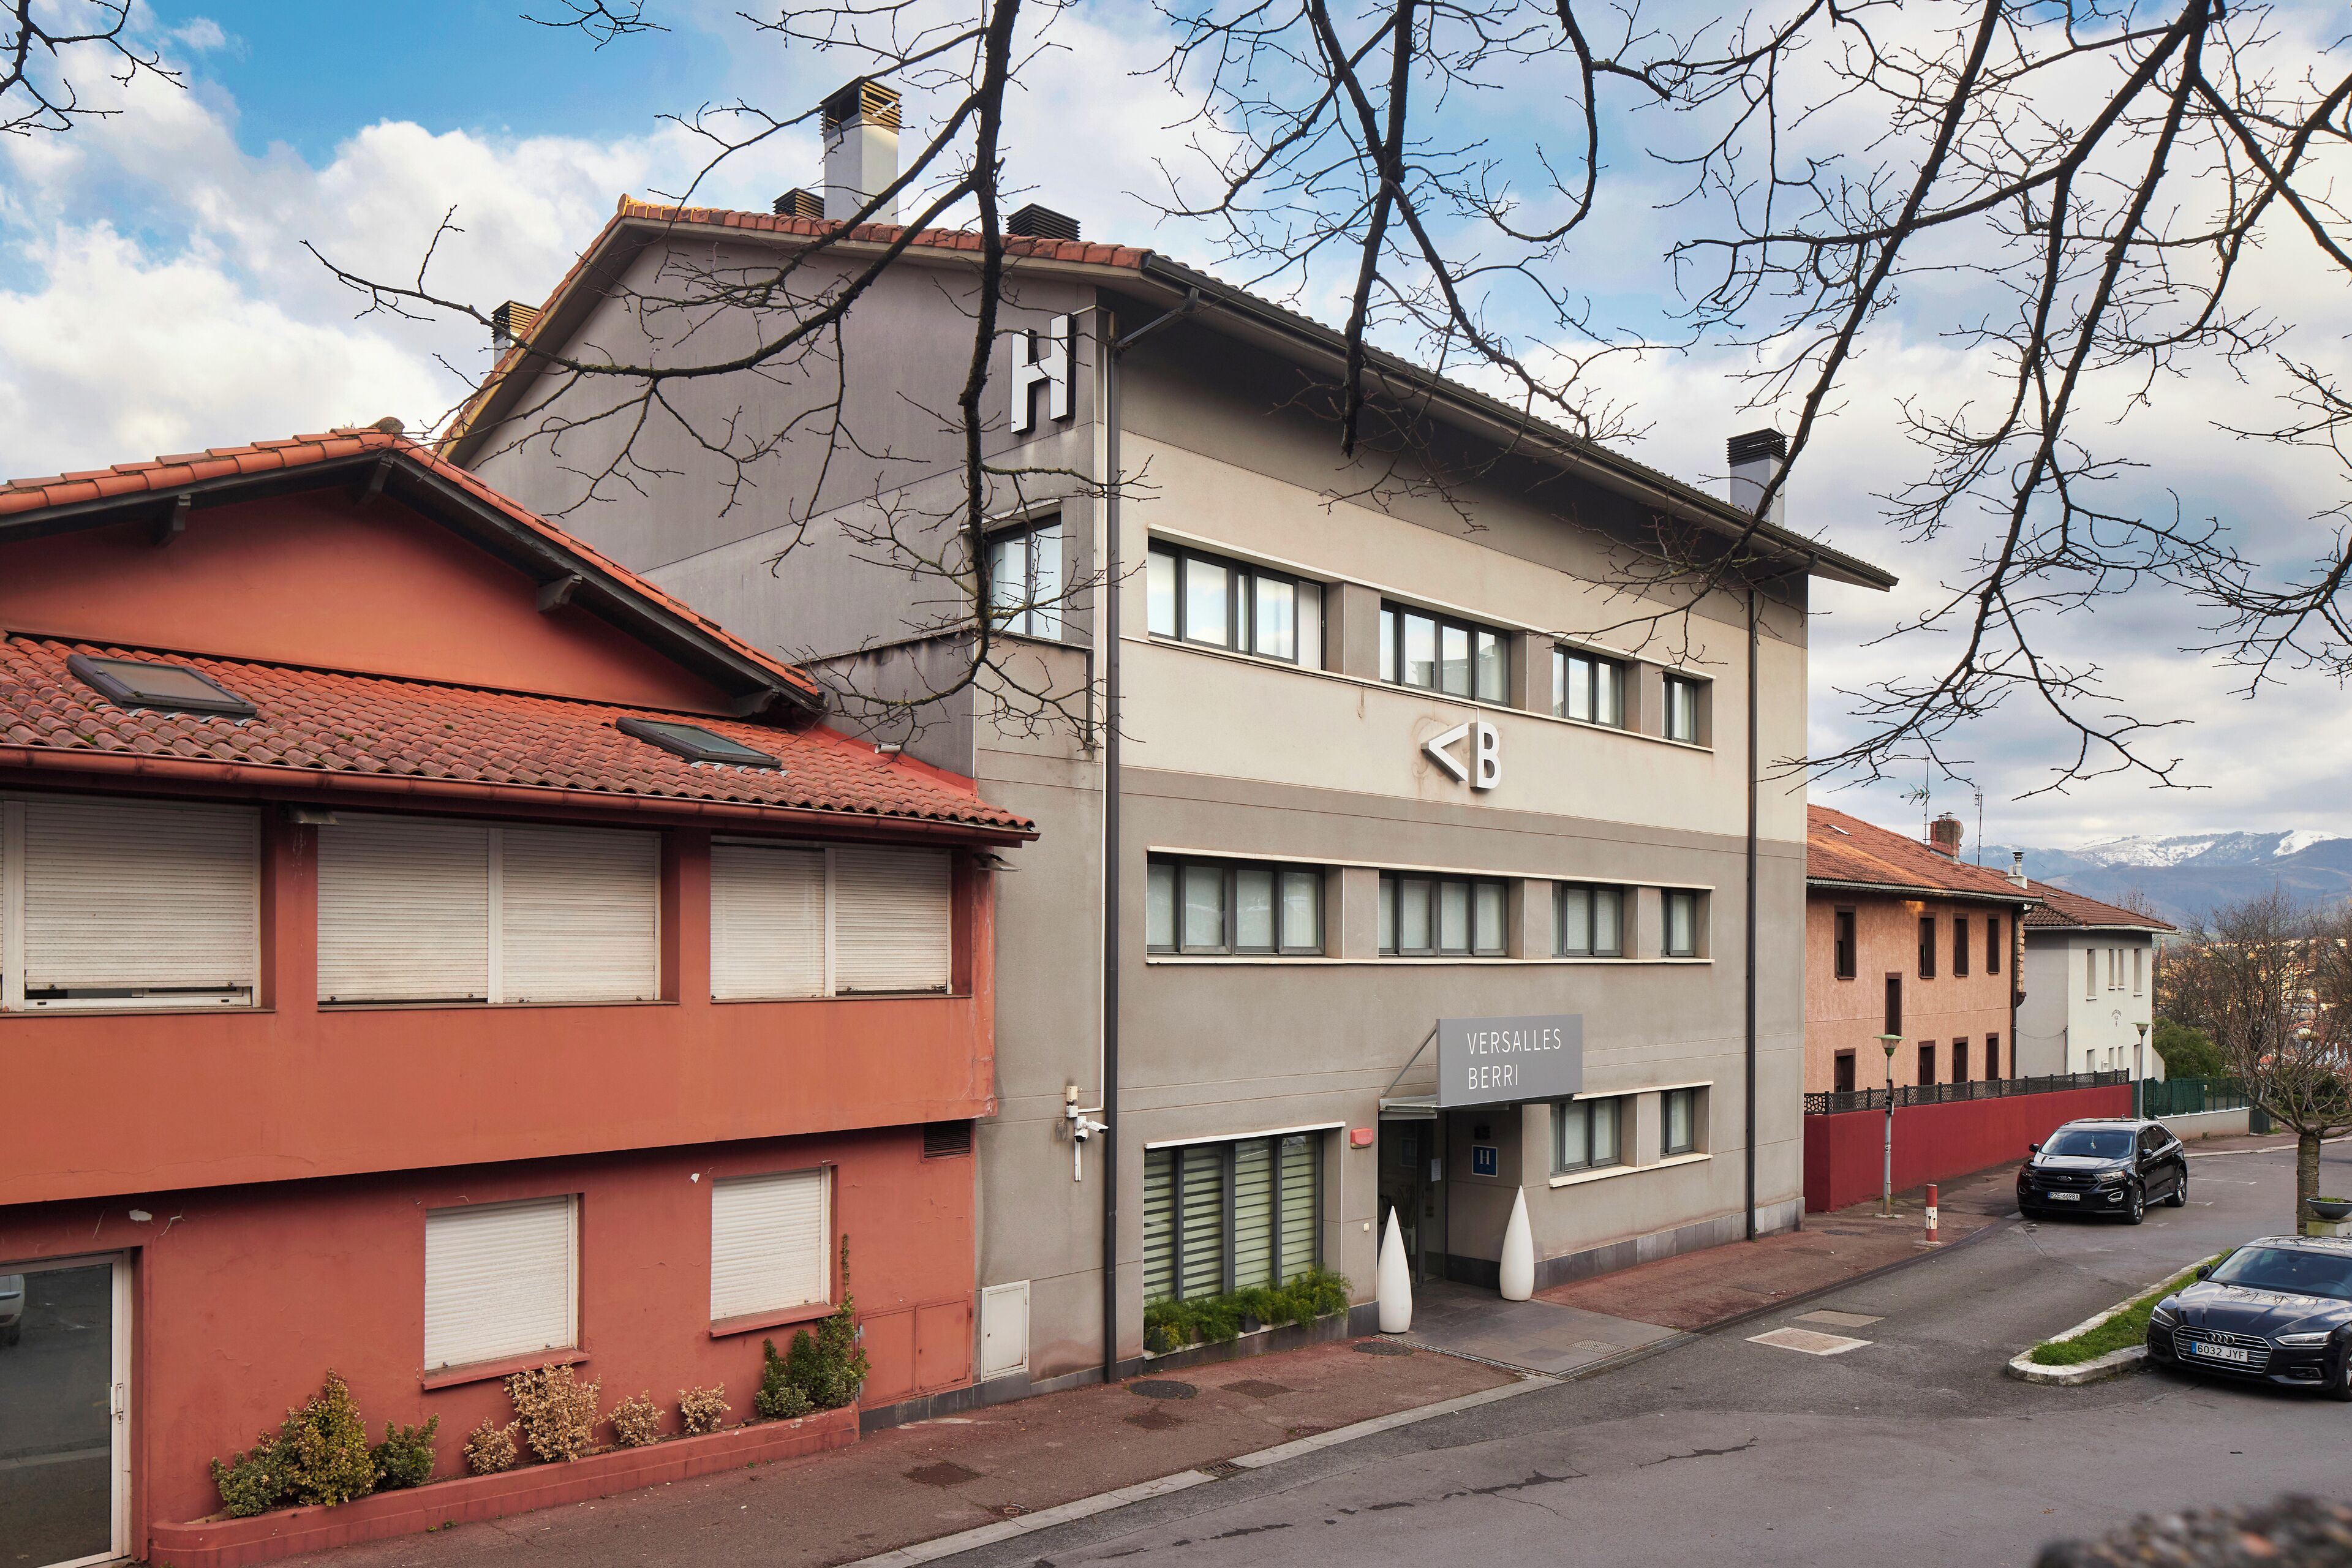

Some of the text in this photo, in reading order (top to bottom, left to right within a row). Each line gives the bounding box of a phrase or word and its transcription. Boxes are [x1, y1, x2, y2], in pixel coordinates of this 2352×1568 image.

[1011, 313, 1075, 434] H
[1467, 1028, 1561, 1055] VERSALLES
[1469, 1064, 1518, 1090] BERRI
[1480, 1150, 1490, 1165] H
[2198, 1344, 2244, 1359] 6032 JYF
